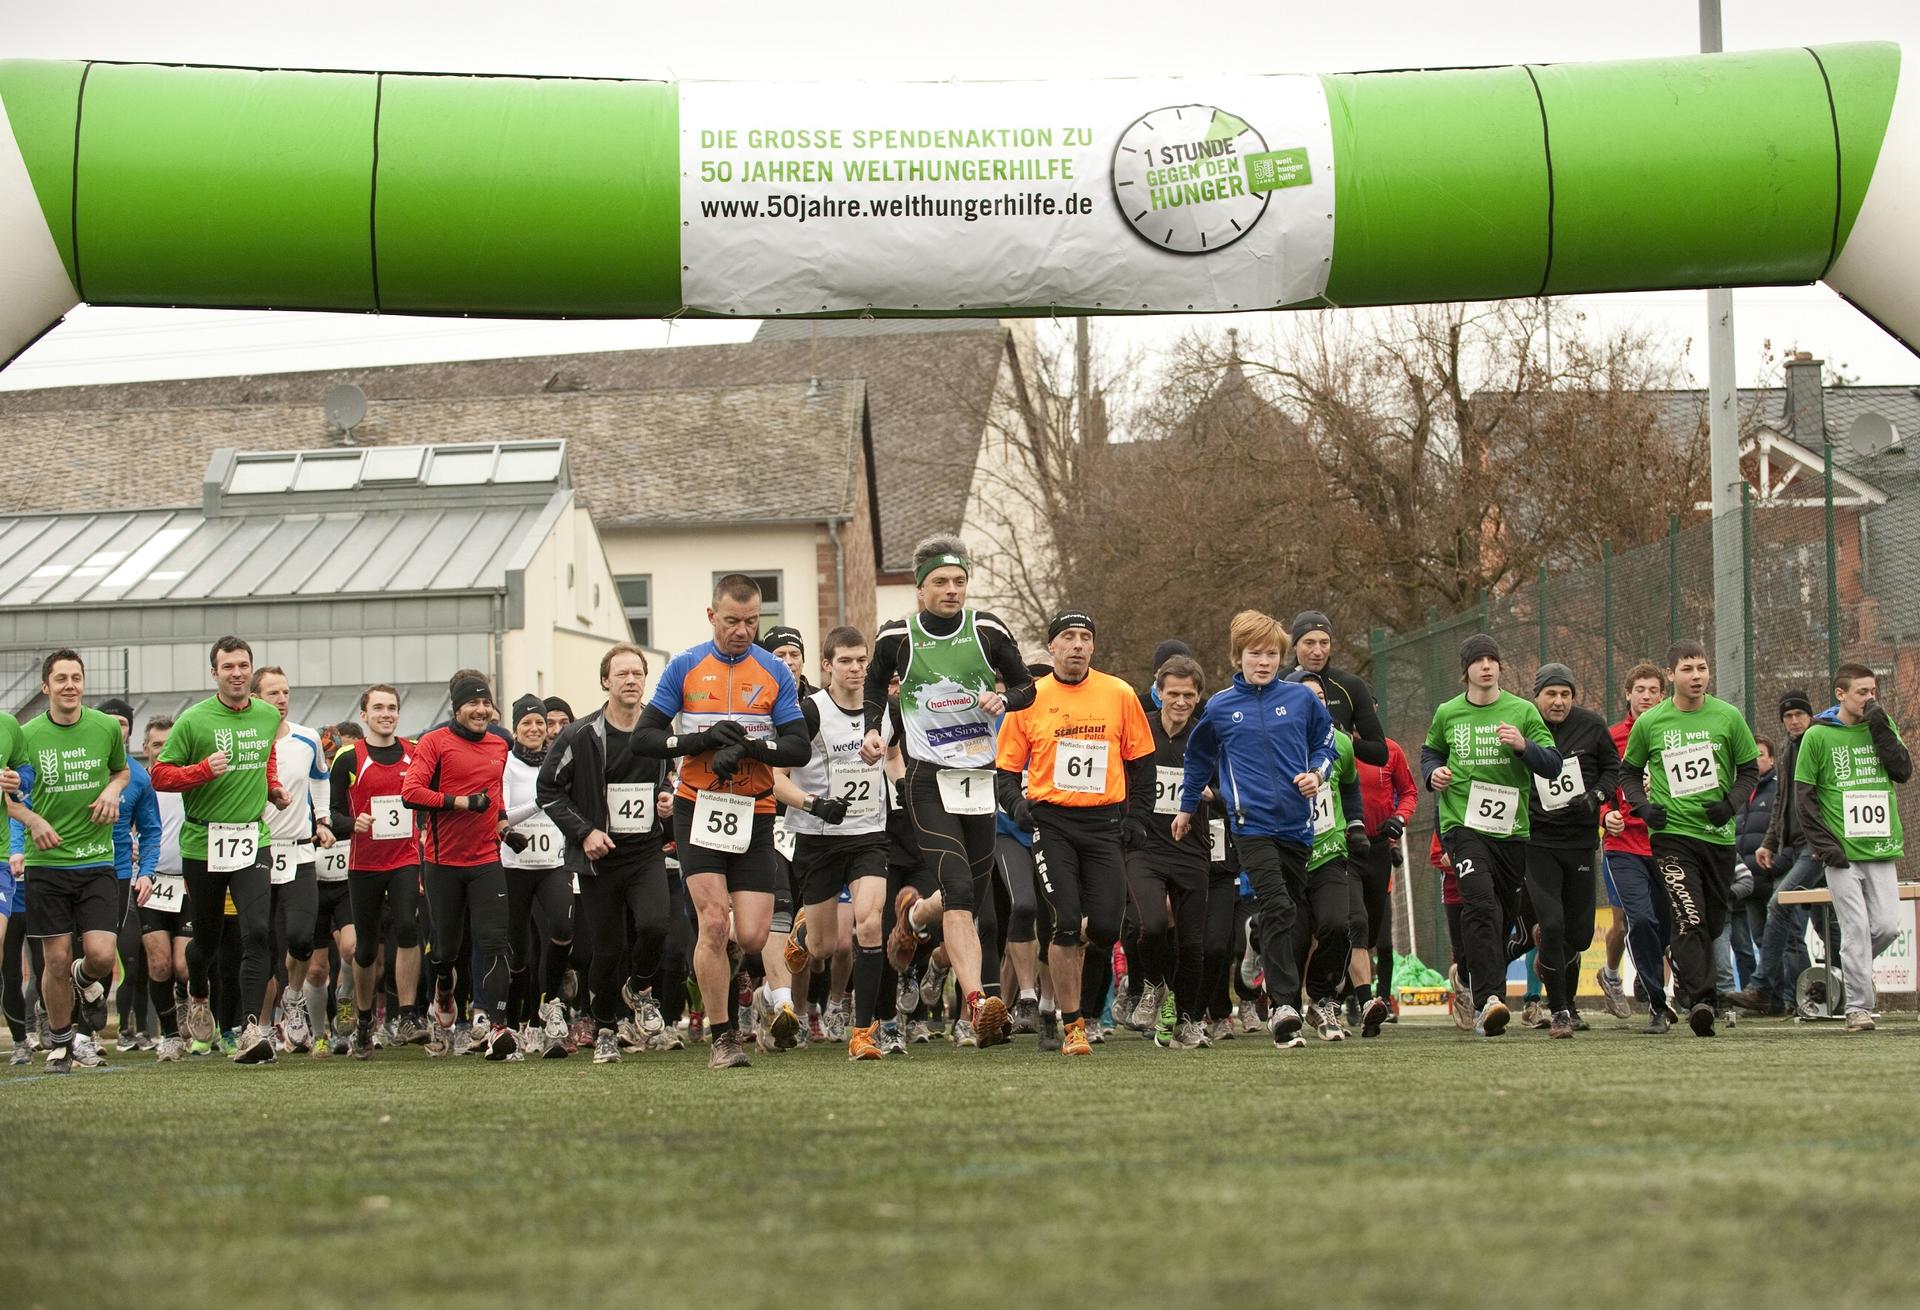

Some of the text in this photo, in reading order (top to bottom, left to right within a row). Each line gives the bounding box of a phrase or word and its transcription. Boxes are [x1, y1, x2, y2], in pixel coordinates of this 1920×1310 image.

[701, 128, 1092, 149] DIE GROSSE SPENDENAKTION ZU
[1144, 137, 1236, 167] 1 STUNDE
[1275, 157, 1293, 165] welt
[701, 159, 1073, 183] 50 JAHREN WELTHUNGERHILFE
[1146, 156, 1240, 187] GEGEN DEN
[1277, 164, 1304, 173] hunger
[1279, 173, 1296, 181] hilfe
[1151, 175, 1245, 211] HUNGER
[700, 192, 1092, 222] www.50jahre.welthungerhilfe.de
[930, 696, 972, 709] hochwald
[1275, 706, 1287, 716] CG
[236, 728, 258, 738] welt
[1054, 724, 1106, 738] Stadtlauf
[1475, 724, 1498, 734] welt
[1686, 730, 1710, 740] welt
[238, 739, 269, 750] hunger
[1060, 741, 1085, 749] Hofladen
[1475, 735, 1502, 747] hung
[62, 747, 87, 759] welt
[238, 751, 260, 762] hilfe
[1476, 747, 1499, 757] hilfe
[1852, 745, 1874, 755] welt
[64, 759, 102, 770] hunger
[1067, 756, 1093, 778] 61
[1671, 758, 1712, 782] 152
[65, 771, 90, 783] hilfe
[1856, 768, 1877, 777] hilfe
[45, 784, 64, 793] AKTION
[844, 781, 870, 801] 22
[961, 777, 970, 798] 1
[1548, 775, 1574, 796] 56
[700, 793, 752, 807] Hofladen Bekond
[618, 799, 645, 819] 42
[1479, 798, 1506, 820] 52
[1850, 805, 1885, 824] 109
[389, 810, 399, 826] 3
[707, 810, 738, 836] 58
[215, 838, 254, 858] 173
[527, 834, 550, 852] 10
[695, 838, 745, 852] Suppengrün Trier
[324, 854, 346, 871] 78
[1456, 858, 1475, 878] 22
[152, 883, 174, 901] 44
